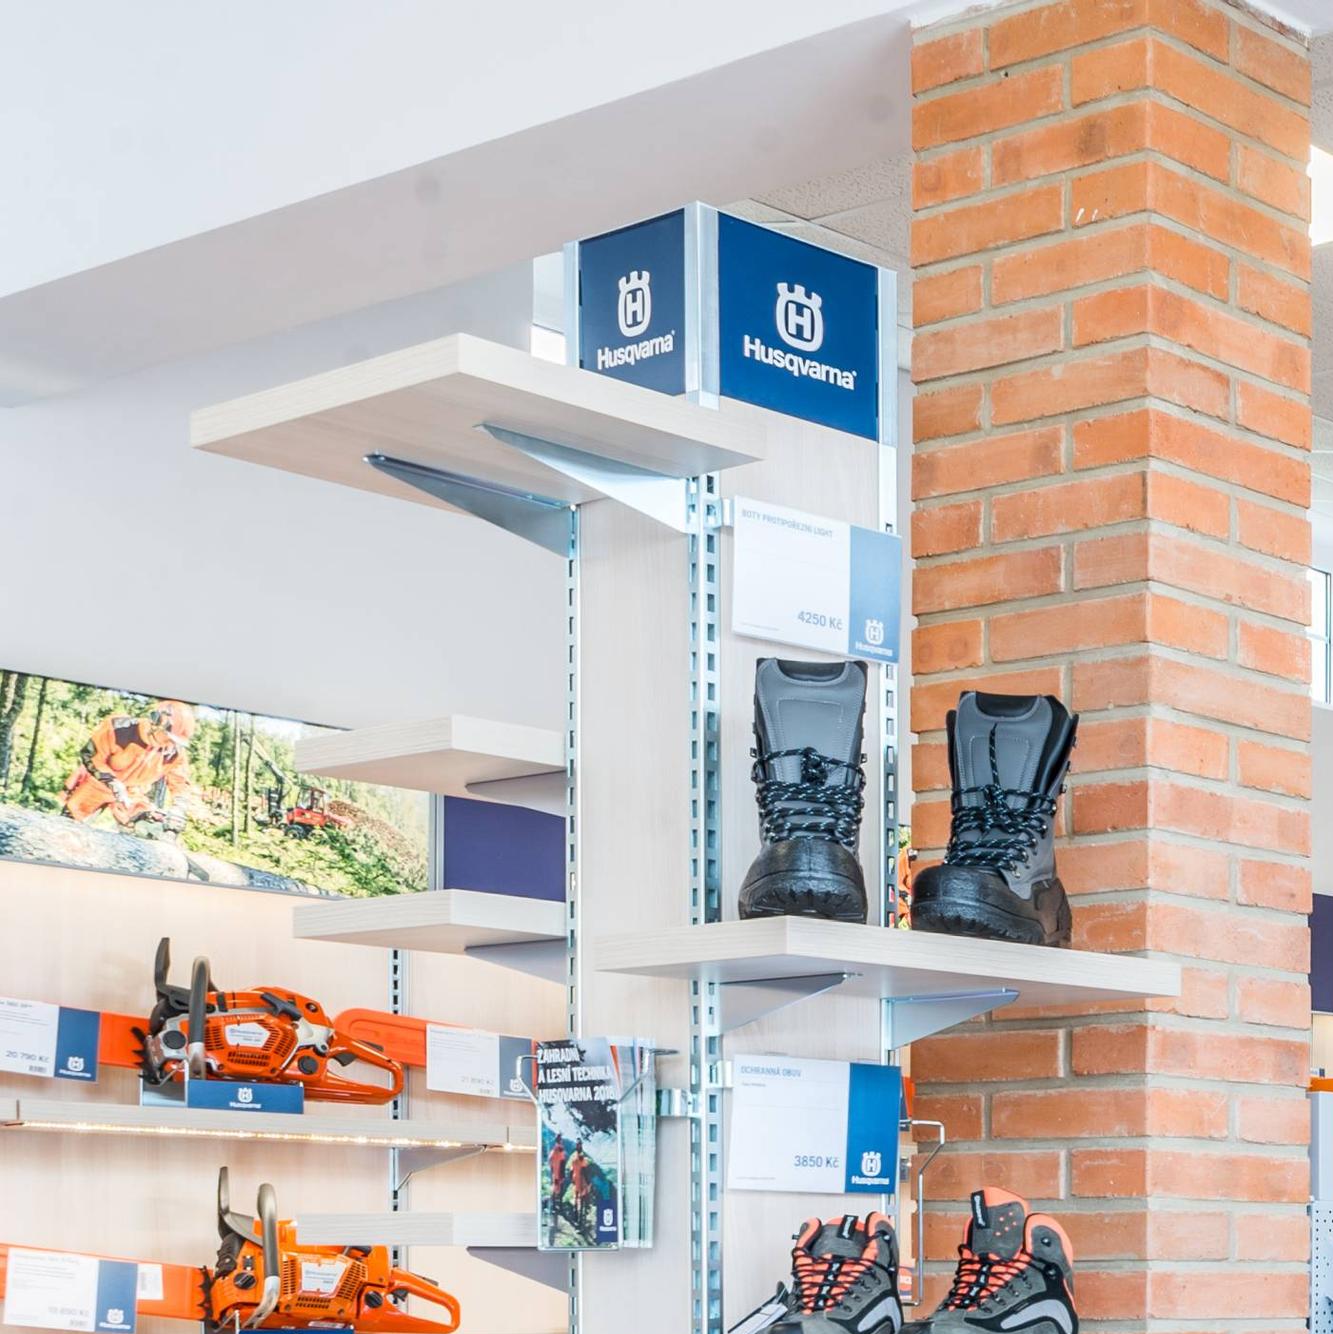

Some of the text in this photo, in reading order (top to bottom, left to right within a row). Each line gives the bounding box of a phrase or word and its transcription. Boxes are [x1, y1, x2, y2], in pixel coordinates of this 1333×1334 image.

[597, 331, 675, 370] Husqvarna
[743, 334, 857, 390] Husqvarna
[797, 610, 827, 628] 4250
[829, 616, 843, 631] Kč
[537, 1046, 580, 1064] ZAHRADNÍ
[538, 1068, 545, 1083] A
[546, 1064, 572, 1083] LESNÍ
[539, 1086, 593, 1104] HUSQVARNA
[794, 1155, 840, 1169] 3850 Kč
